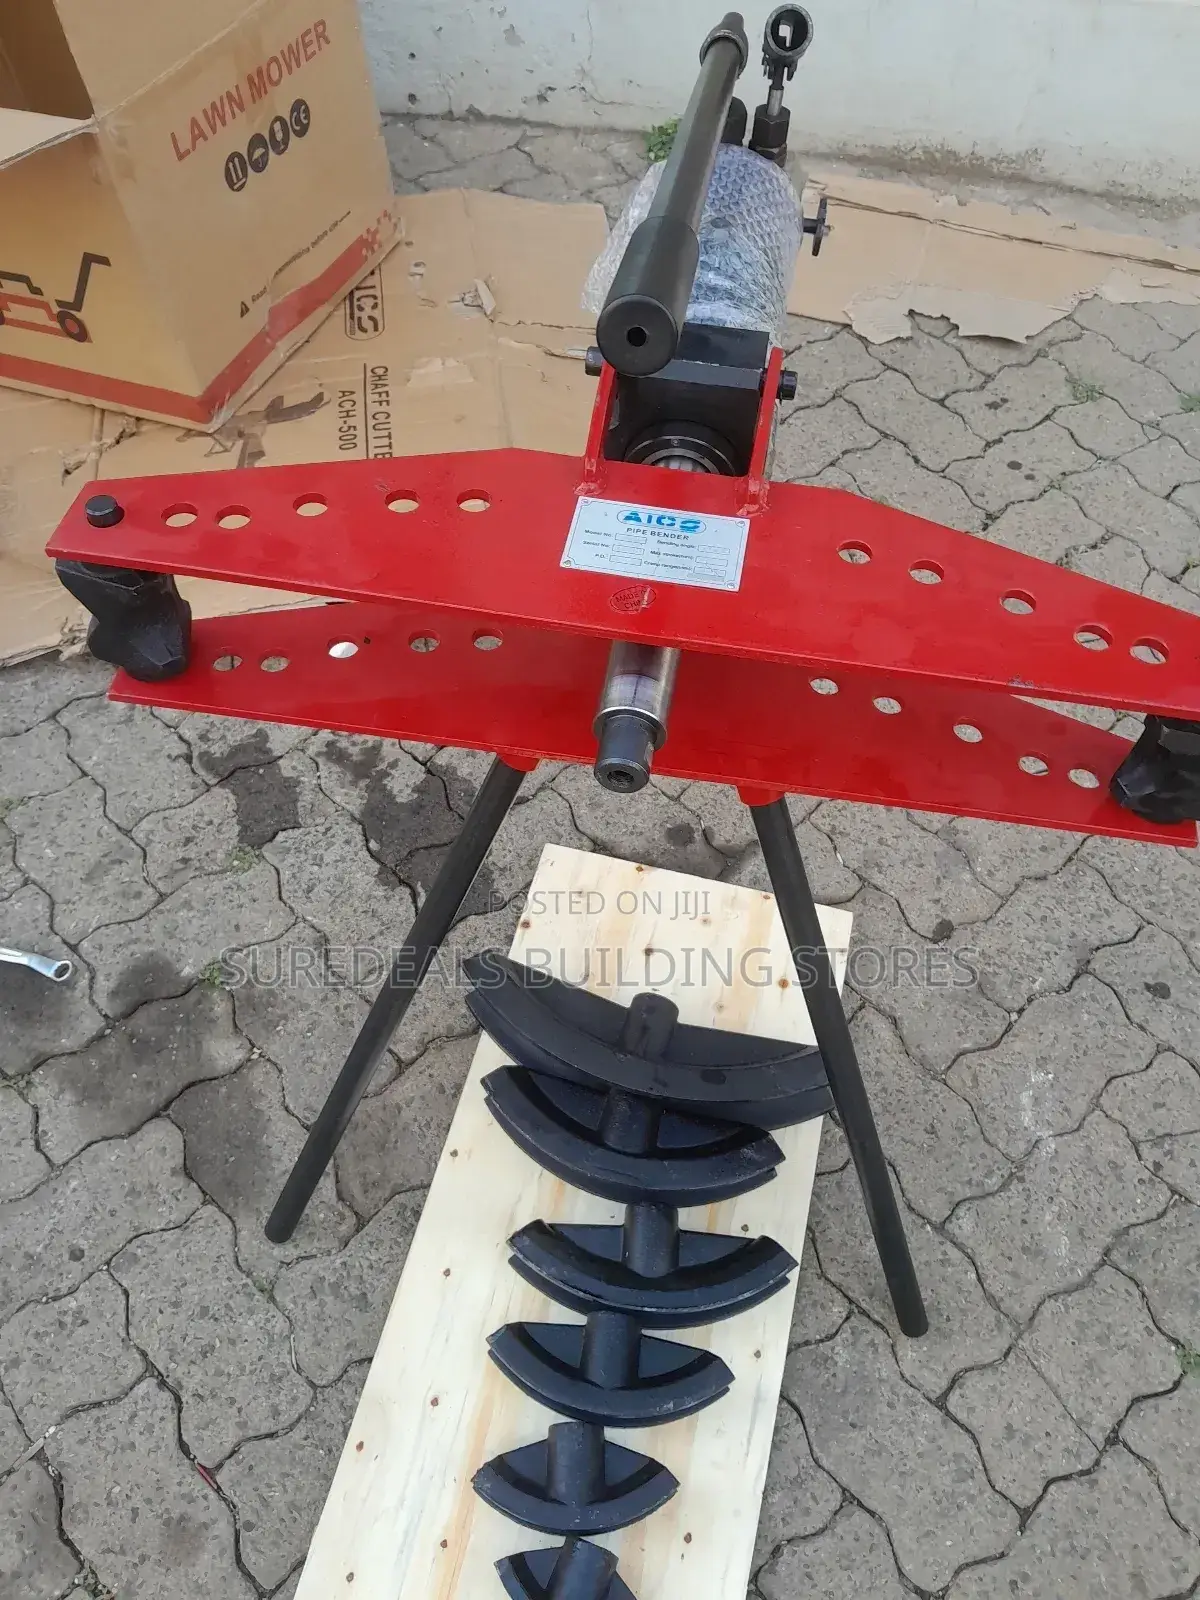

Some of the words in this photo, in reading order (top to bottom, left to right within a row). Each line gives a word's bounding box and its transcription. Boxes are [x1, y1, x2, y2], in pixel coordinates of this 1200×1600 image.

[170, 84, 246, 162] LAWN
[246, 19, 331, 104] MOWER
[355, 269, 379, 334] ICS
[370, 366, 390, 407] CHAFF
[338, 390, 358, 451] ACH-500
[626, 527, 648, 536] PIPE
[650, 530, 690, 541] BENDER
